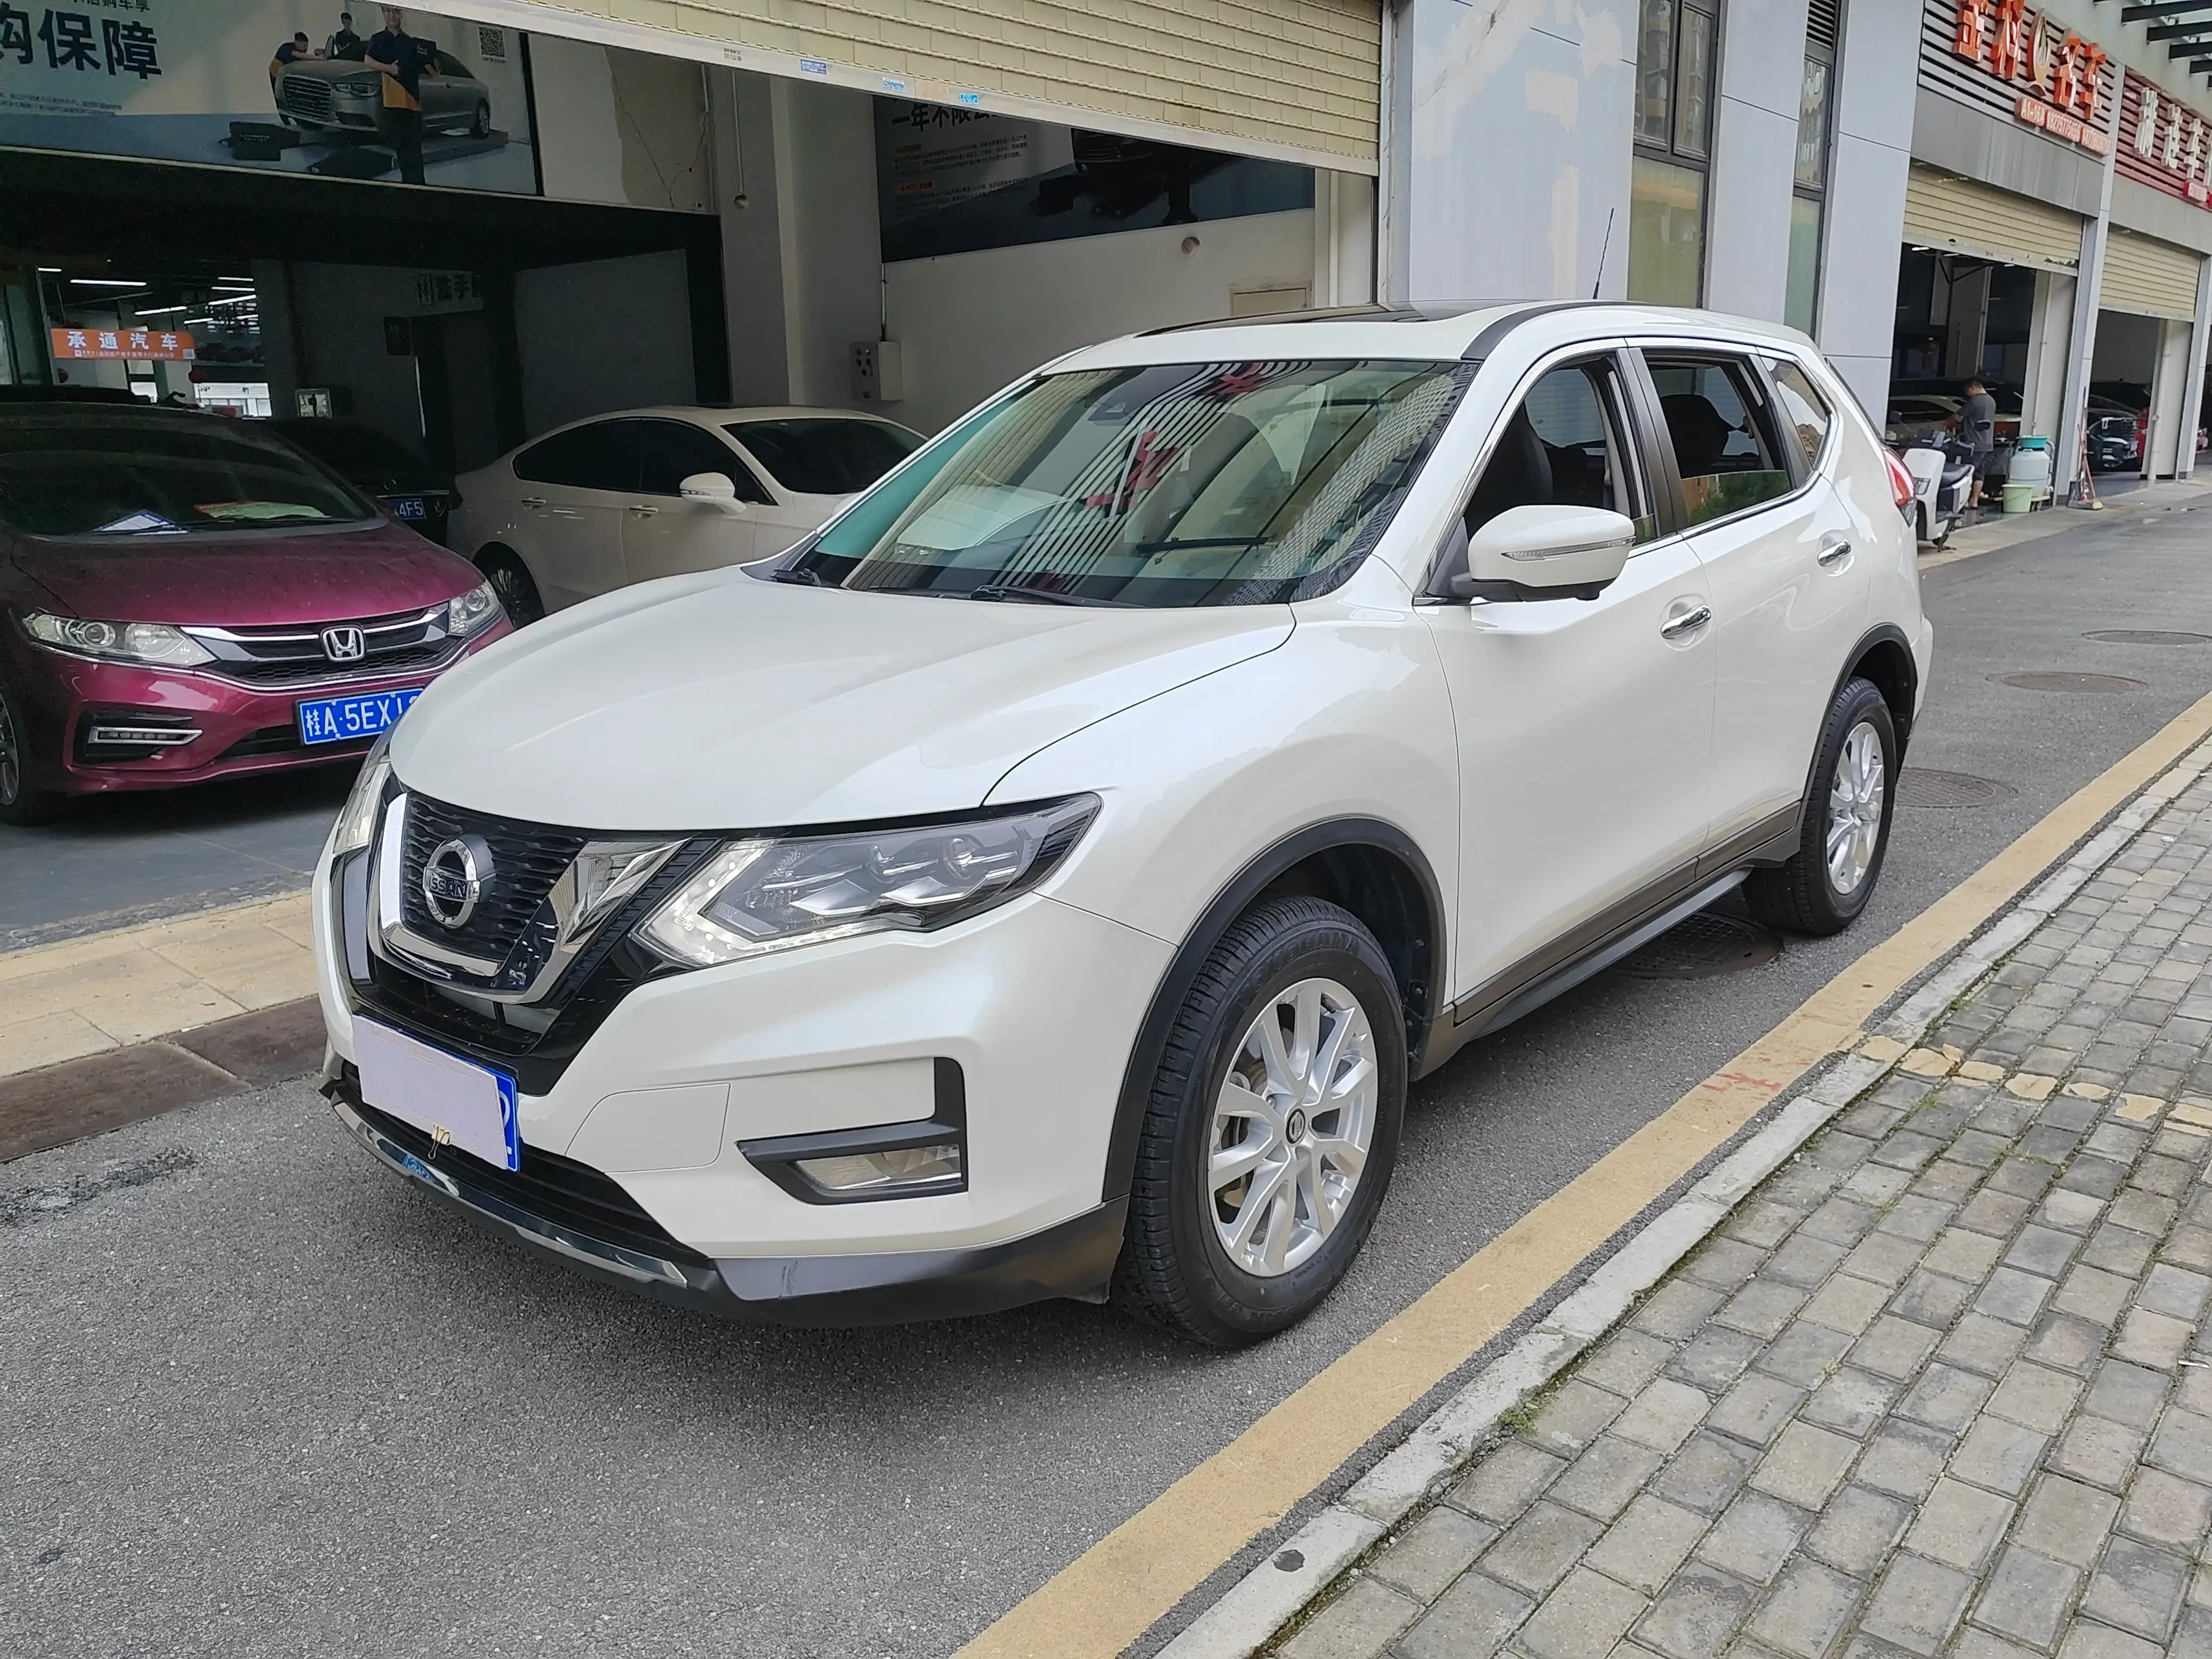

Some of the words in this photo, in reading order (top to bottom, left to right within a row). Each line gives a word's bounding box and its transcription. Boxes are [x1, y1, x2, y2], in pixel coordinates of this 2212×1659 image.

[66, 330, 178, 352] 承通汽车
[306, 696, 419, 737] 桂A·5EX1
[425, 871, 467, 899] NISSAN
